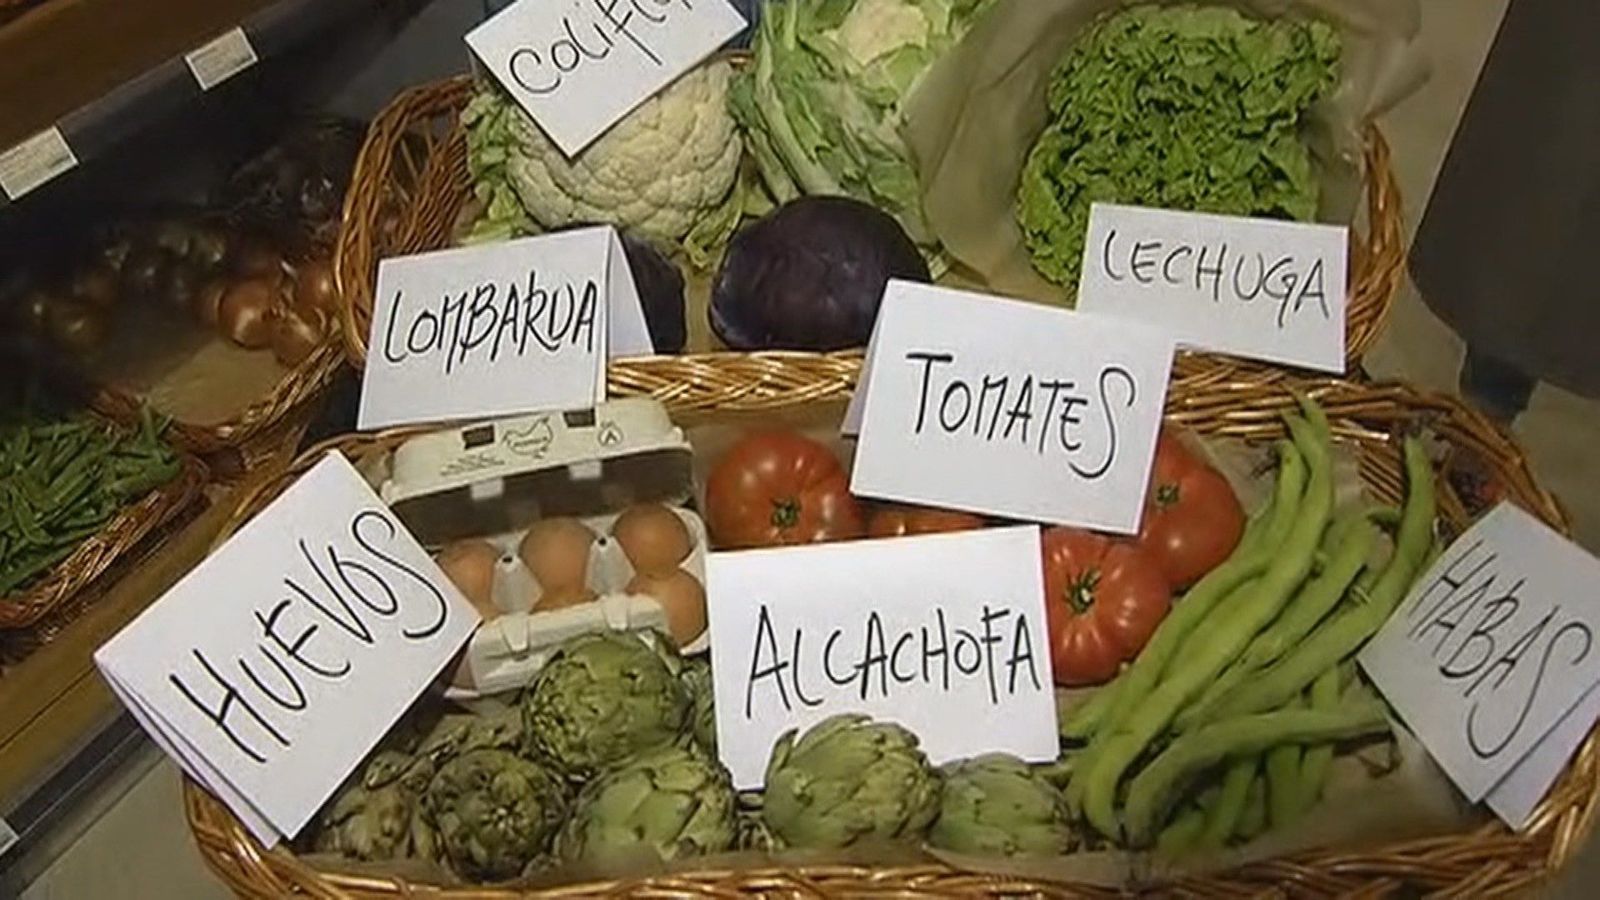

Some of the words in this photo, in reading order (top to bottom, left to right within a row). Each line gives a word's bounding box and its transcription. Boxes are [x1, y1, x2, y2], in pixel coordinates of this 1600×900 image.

[1104, 230, 1329, 328] LECHUGA
[906, 352, 1136, 479] TOMATES
[169, 510, 447, 763] HUEVOS
[746, 605, 1041, 719] ALCACHOFA
[1407, 540, 1591, 759] HABAS
